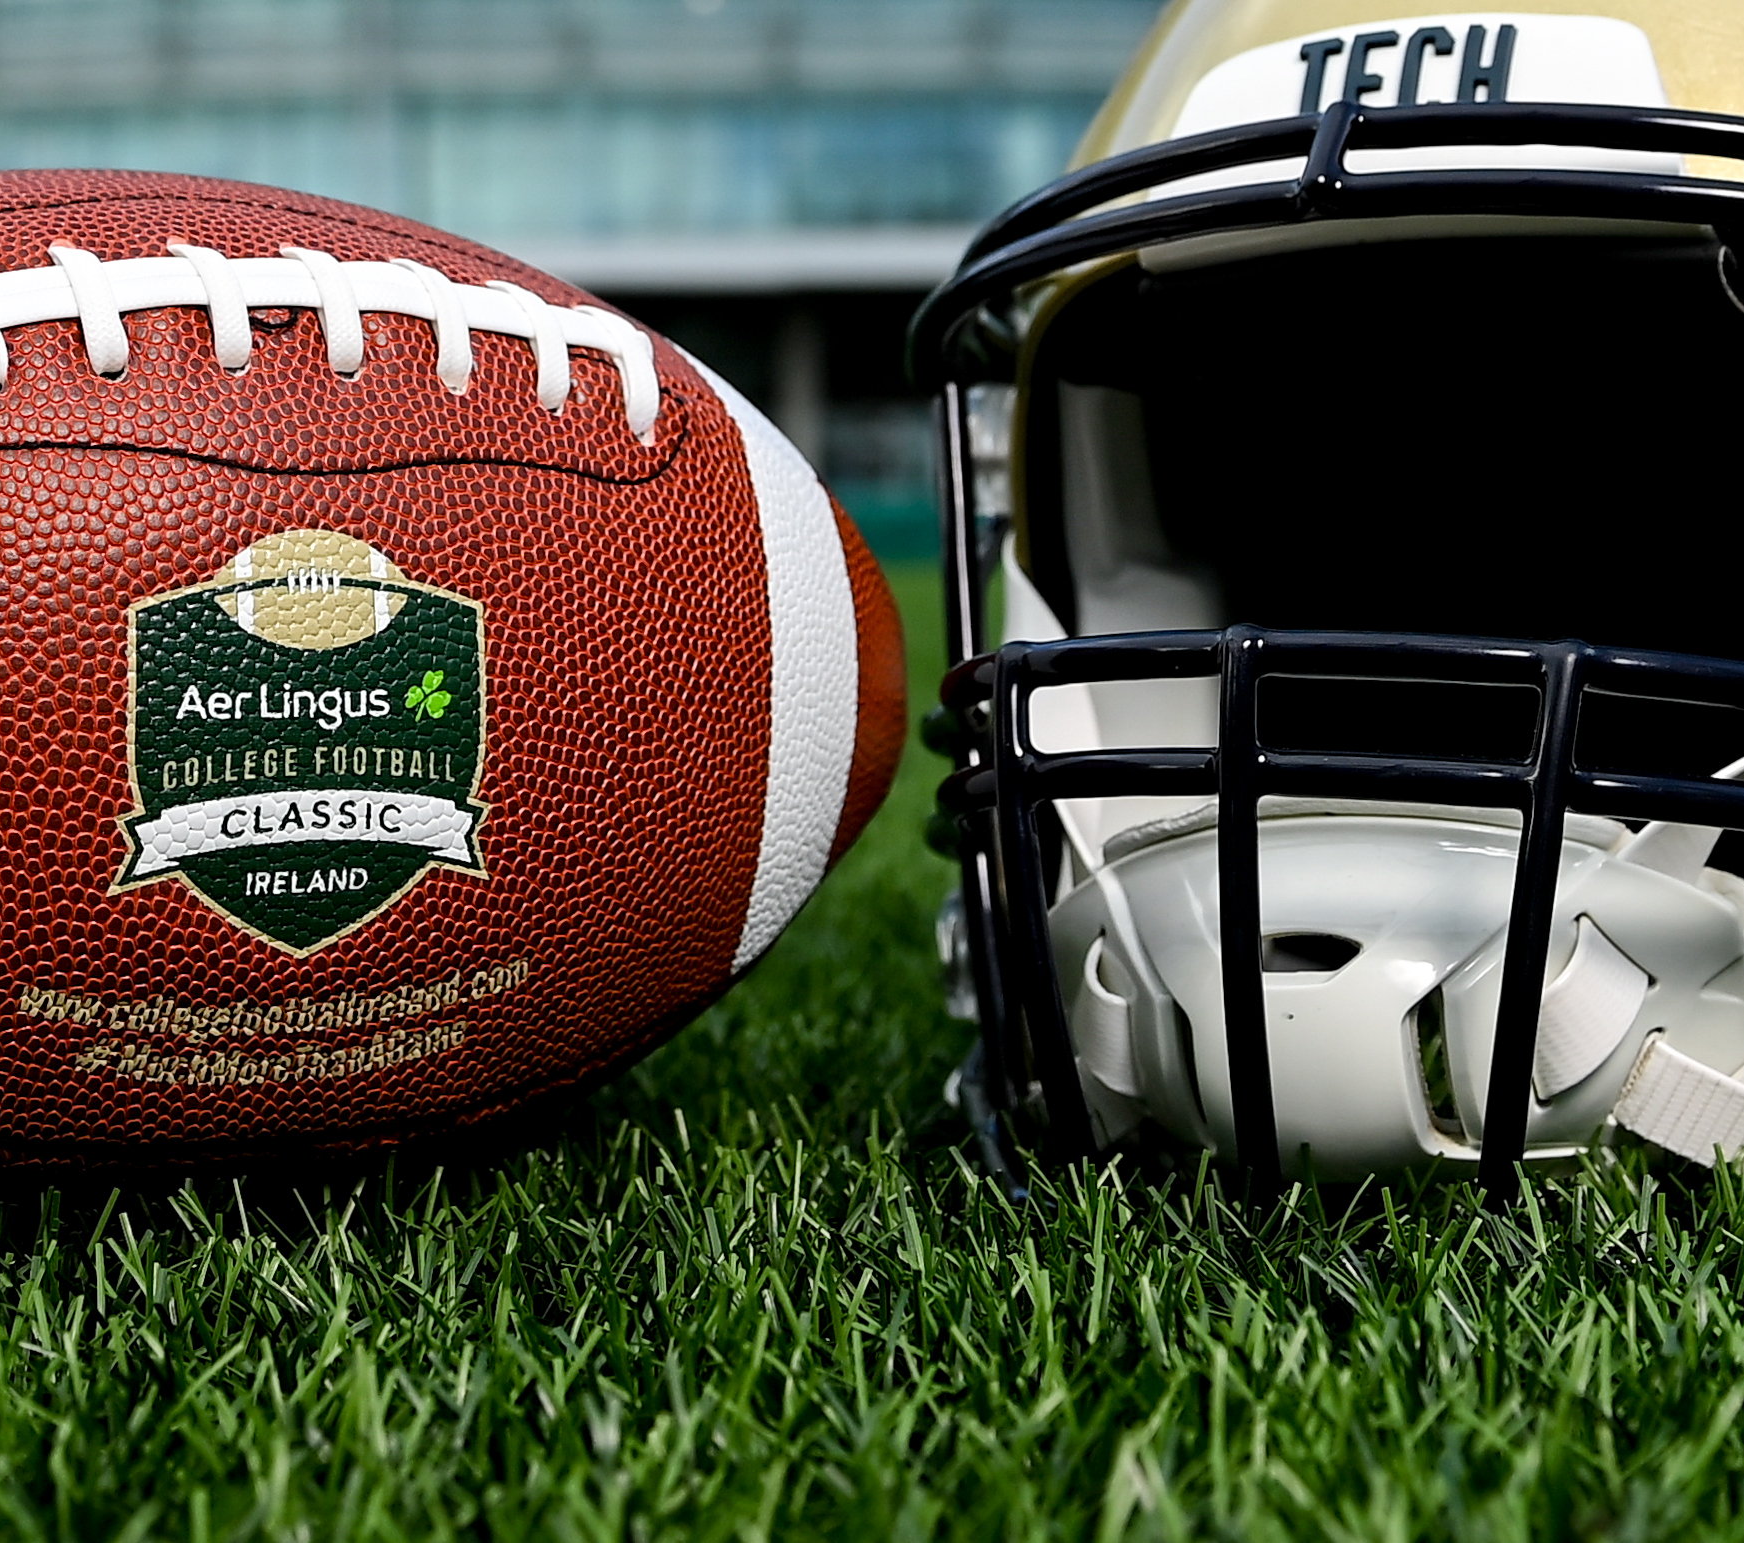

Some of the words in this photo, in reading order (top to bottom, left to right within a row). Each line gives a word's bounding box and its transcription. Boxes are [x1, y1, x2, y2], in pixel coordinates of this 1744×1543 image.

[1299, 24, 1518, 114] TECH
[176, 685, 253, 720] Aer
[259, 682, 391, 730] Lingus
[162, 748, 298, 792] COLLEGE
[314, 745, 456, 783] FOOTBALL
[220, 800, 403, 838] CLASSIC
[245, 867, 369, 896] IRELAND
